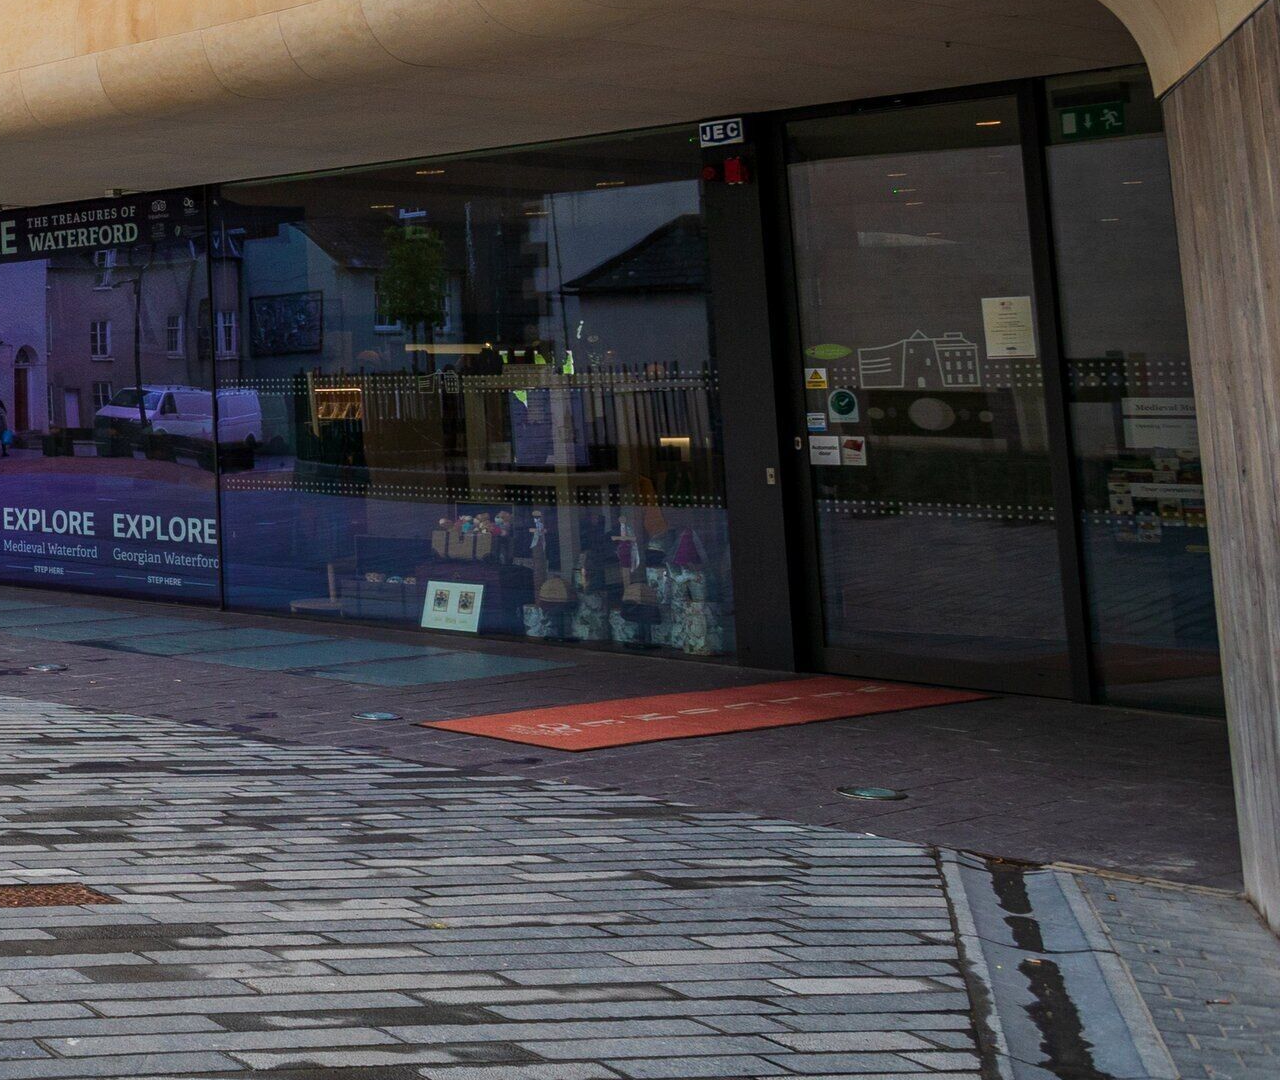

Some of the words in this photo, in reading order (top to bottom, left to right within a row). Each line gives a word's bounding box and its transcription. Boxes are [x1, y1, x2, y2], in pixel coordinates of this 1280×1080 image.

[702, 122, 739, 141] JEC
[27, 216, 49, 229] THE
[51, 207, 118, 226] TREASURES
[121, 206, 137, 218] OF
[28, 222, 139, 252] WATERFORD
[3, 507, 96, 536] EXPLORE
[113, 513, 218, 545] EXPLORE
[3, 539, 46, 555] Medieval
[48, 543, 98, 559] Waterford
[113, 548, 161, 565] Georgian
[34, 565, 48, 574] STEP
[49, 567, 65, 576] HERE
[147, 575, 164, 585] STEP
[164, 577, 182, 587] HERE
